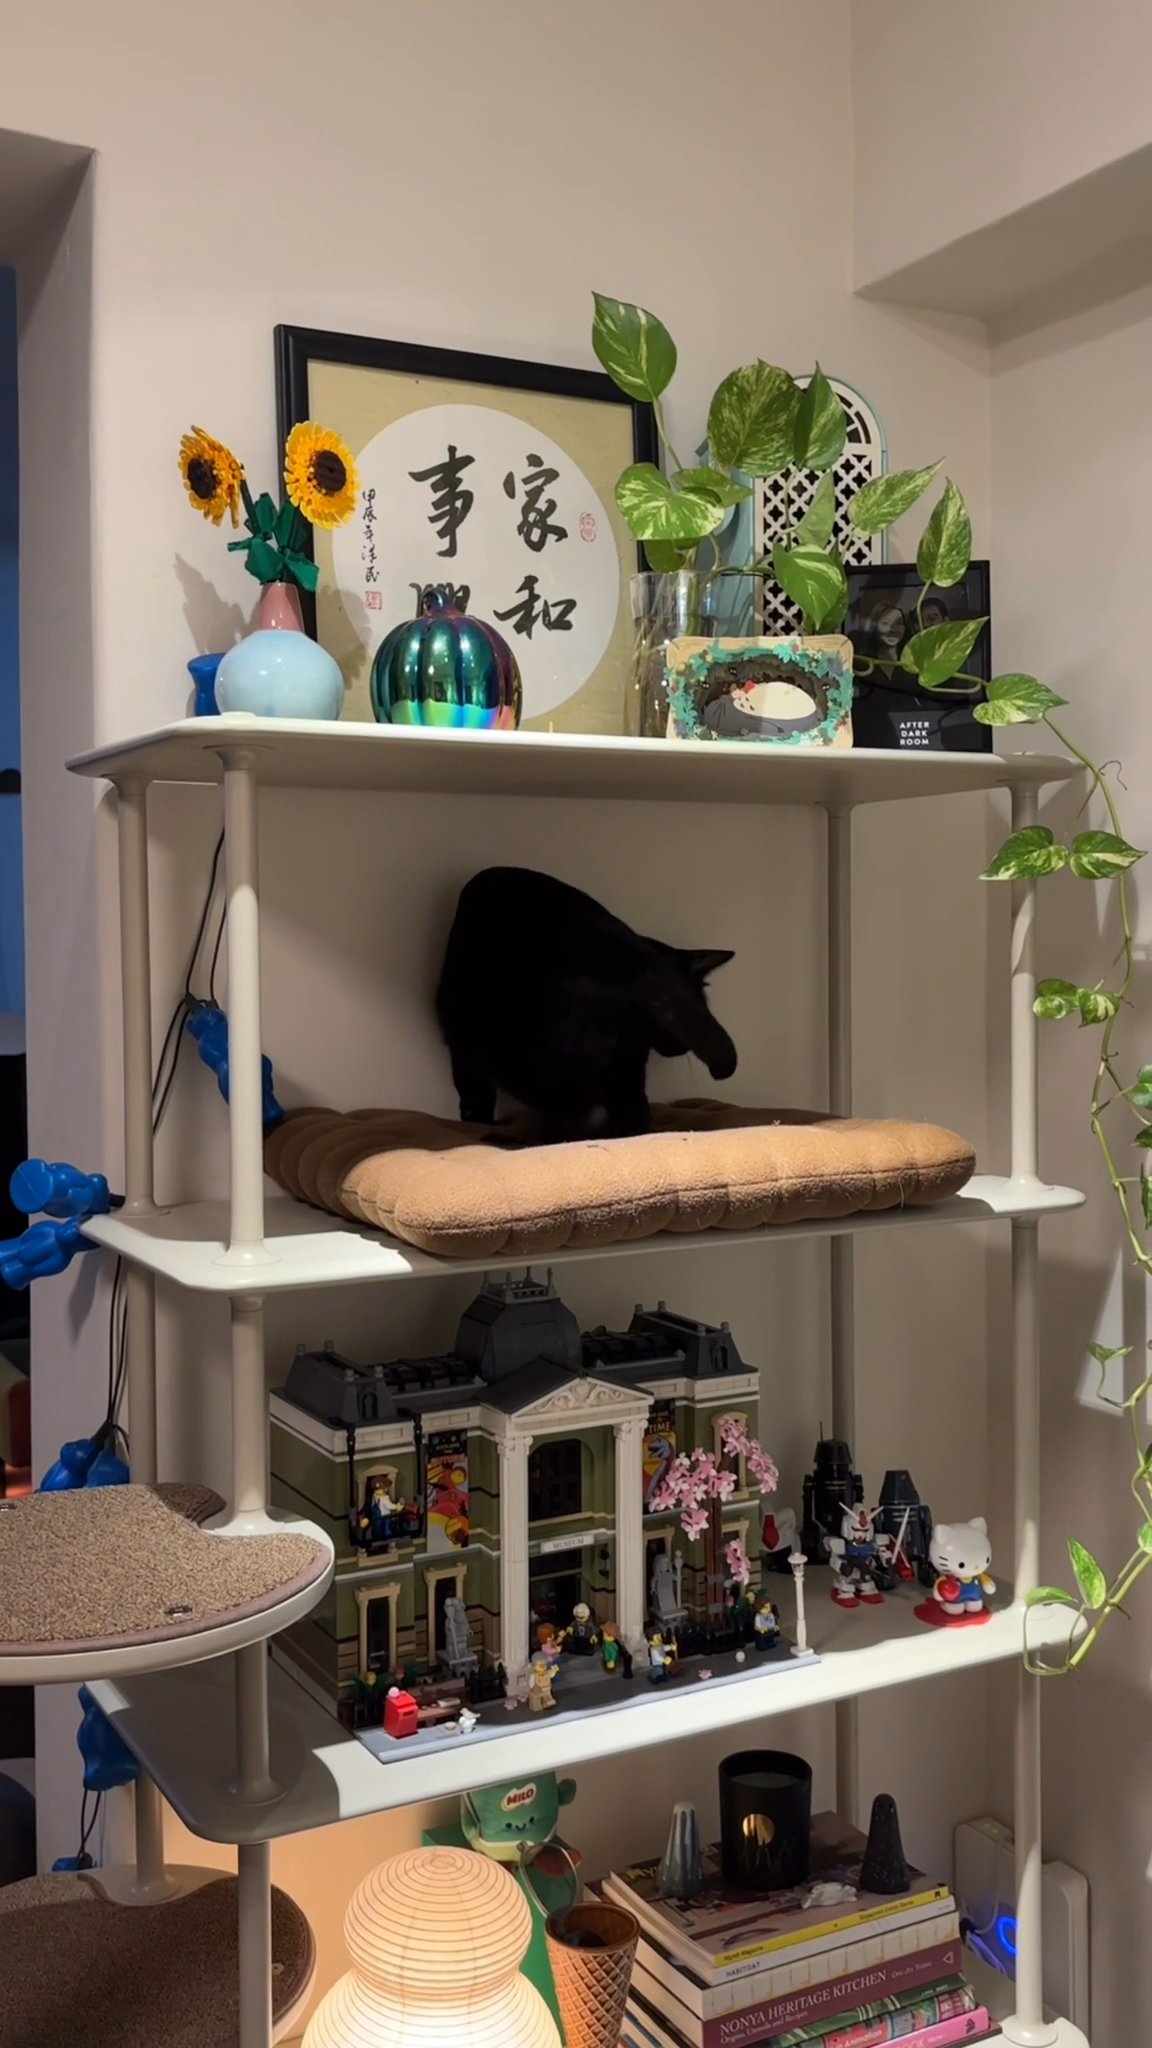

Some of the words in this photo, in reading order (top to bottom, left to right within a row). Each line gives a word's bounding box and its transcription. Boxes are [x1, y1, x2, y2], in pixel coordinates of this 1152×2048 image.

[900, 721, 930, 729] AFTER
[900, 738, 930, 746] ROOM
[649, 1421, 671, 1434] TIME
[552, 1537, 585, 1549] MUSEUM
[507, 1788, 534, 1805] MILO
[720, 2011, 766, 2036] NONYA
[769, 1990, 831, 2020] HERITAGE
[833, 1970, 887, 1999] KITCHEN
